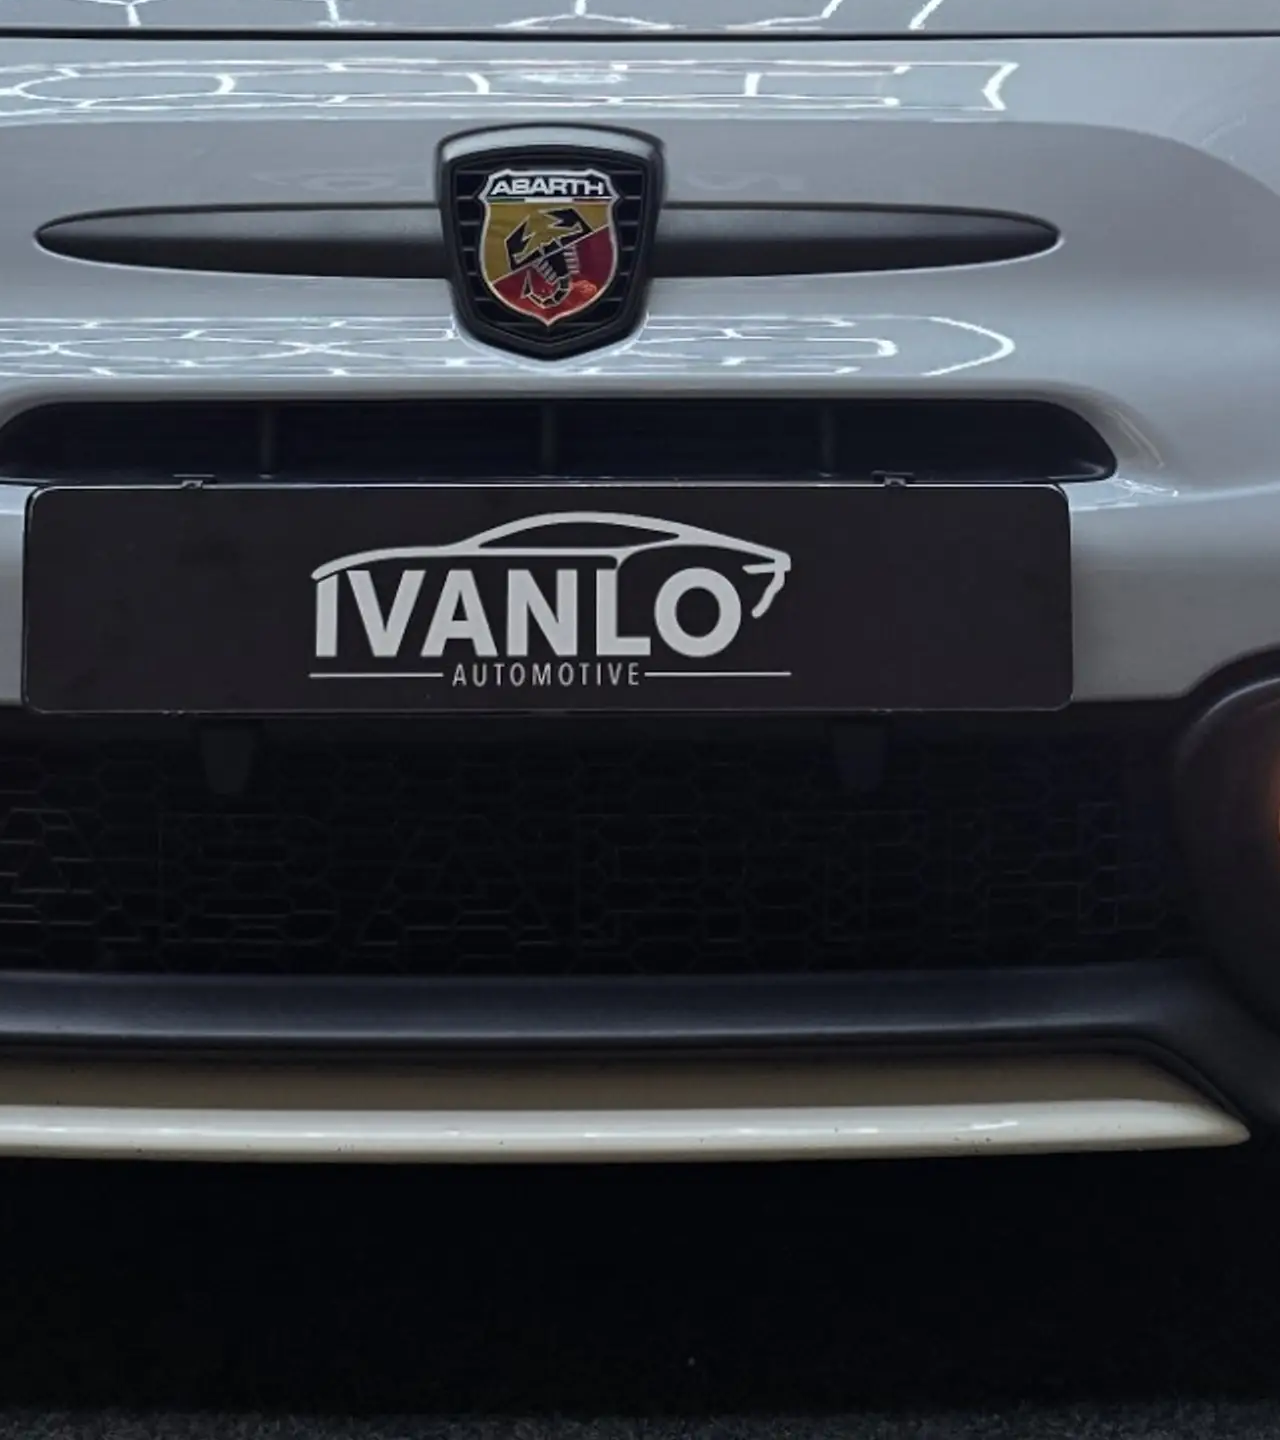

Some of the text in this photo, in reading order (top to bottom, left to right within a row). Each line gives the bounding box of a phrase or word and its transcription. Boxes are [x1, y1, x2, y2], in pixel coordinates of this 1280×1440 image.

[491, 178, 604, 196] ABARTH
[316, 567, 742, 658] IVANLO
[451, 662, 640, 687] AUTOMOTIVE
